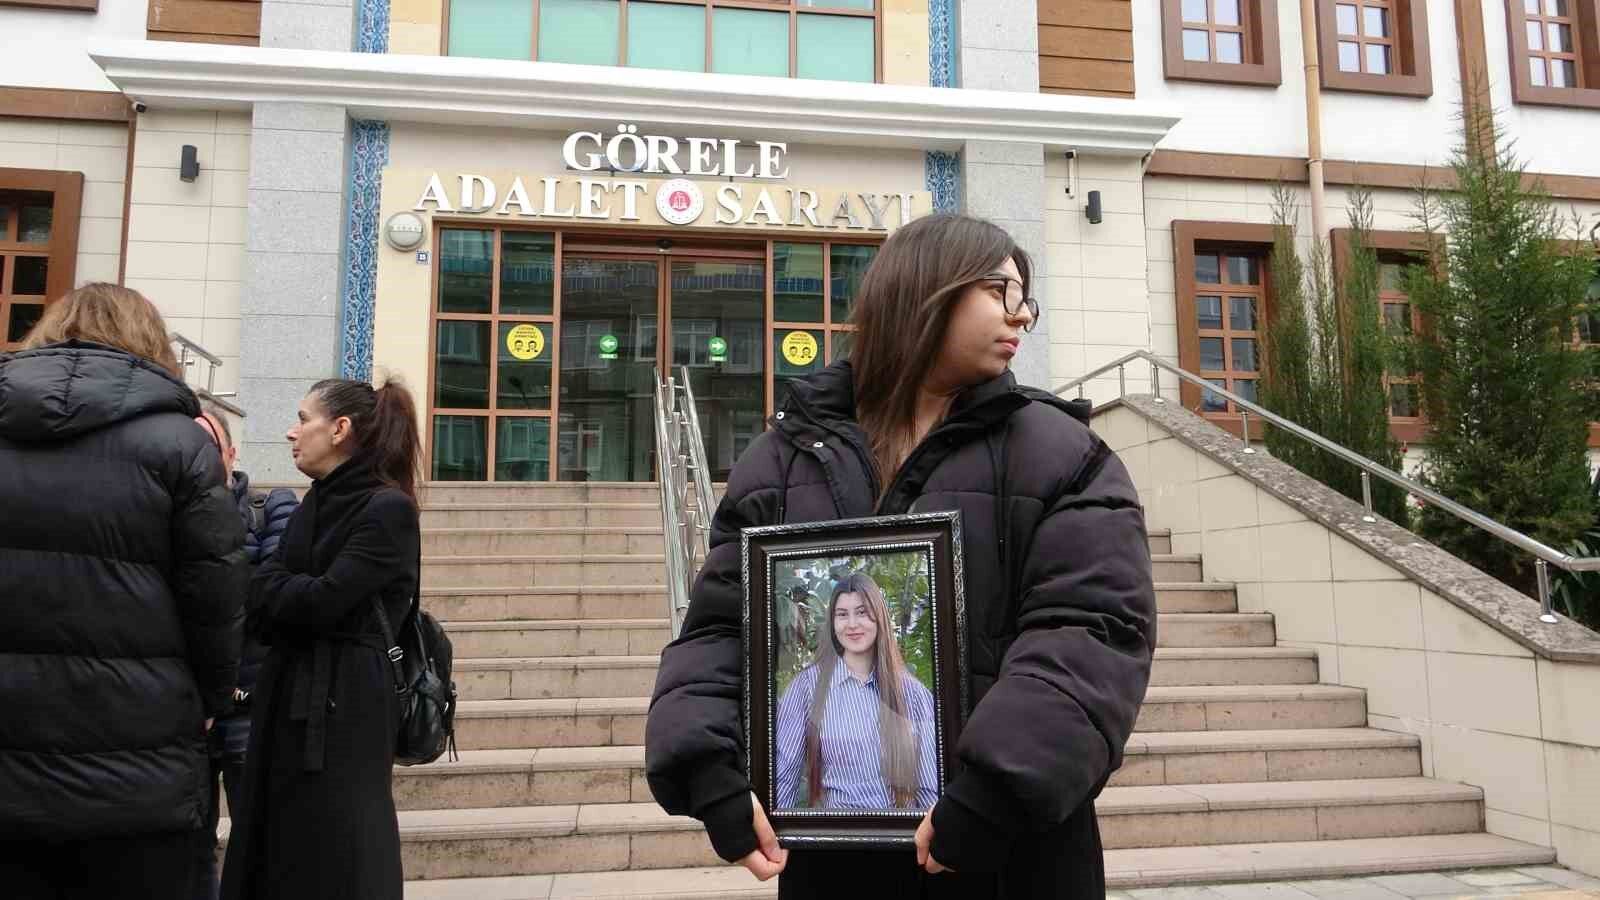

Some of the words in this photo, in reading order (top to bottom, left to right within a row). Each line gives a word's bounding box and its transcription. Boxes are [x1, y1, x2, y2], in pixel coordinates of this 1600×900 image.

[562, 123, 789, 179] GÖRELE
[413, 171, 648, 221] ADALET
[715, 184, 914, 231] SARAYI
